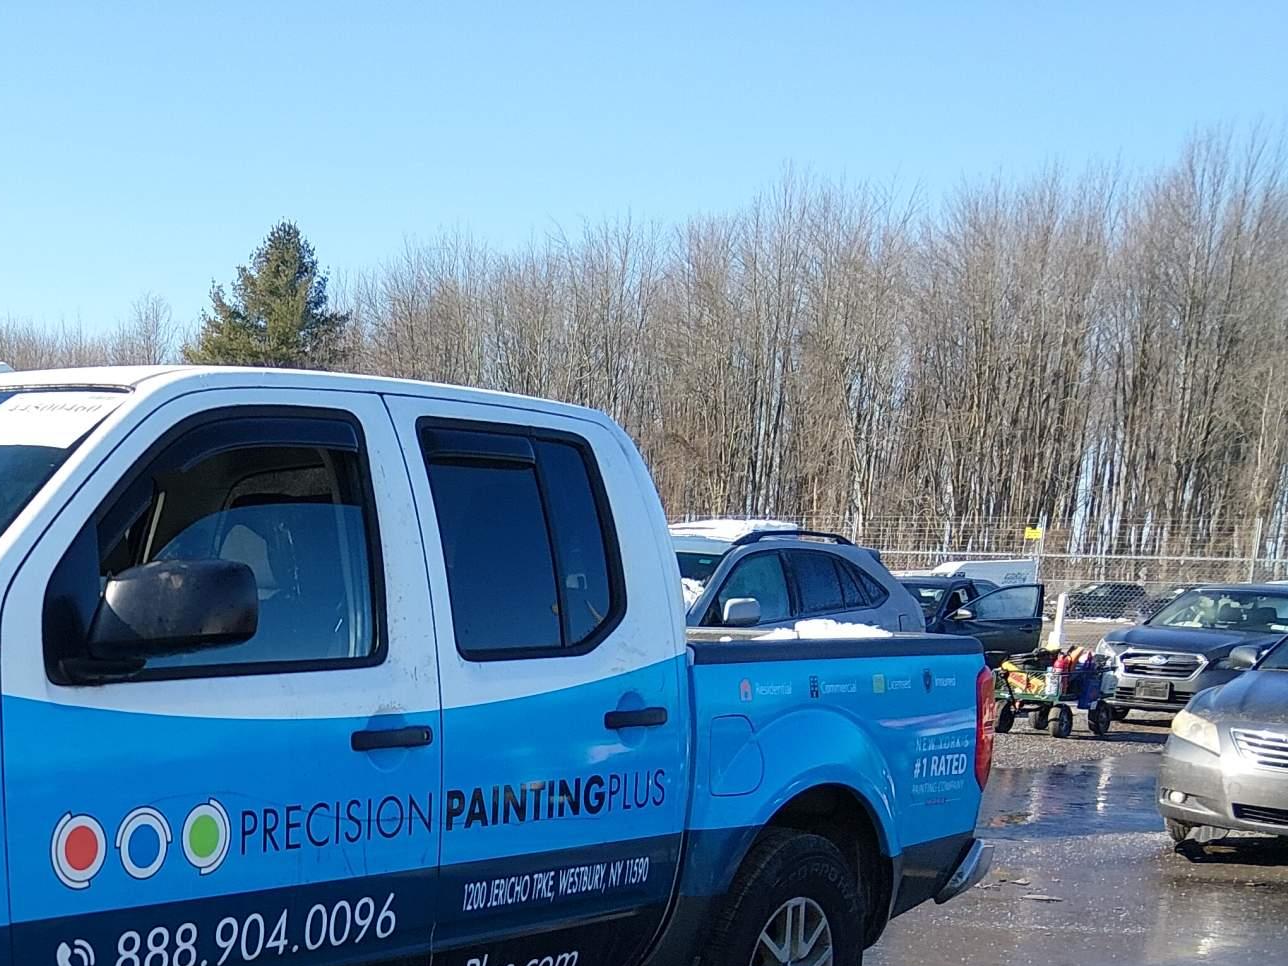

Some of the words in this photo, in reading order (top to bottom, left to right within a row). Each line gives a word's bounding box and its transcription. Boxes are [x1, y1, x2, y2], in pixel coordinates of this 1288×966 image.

[913, 757, 928, 779] #1
[930, 753, 968, 777] RATED
[240, 792, 433, 856] PRECISION
[462, 881, 488, 911] 1200
[487, 874, 530, 907] JERICHO
[532, 870, 556, 902] TPKE,
[558, 862, 607, 894] WESTBURY,
[608, 860, 625, 886] NY
[624, 856, 650, 885] 11590
